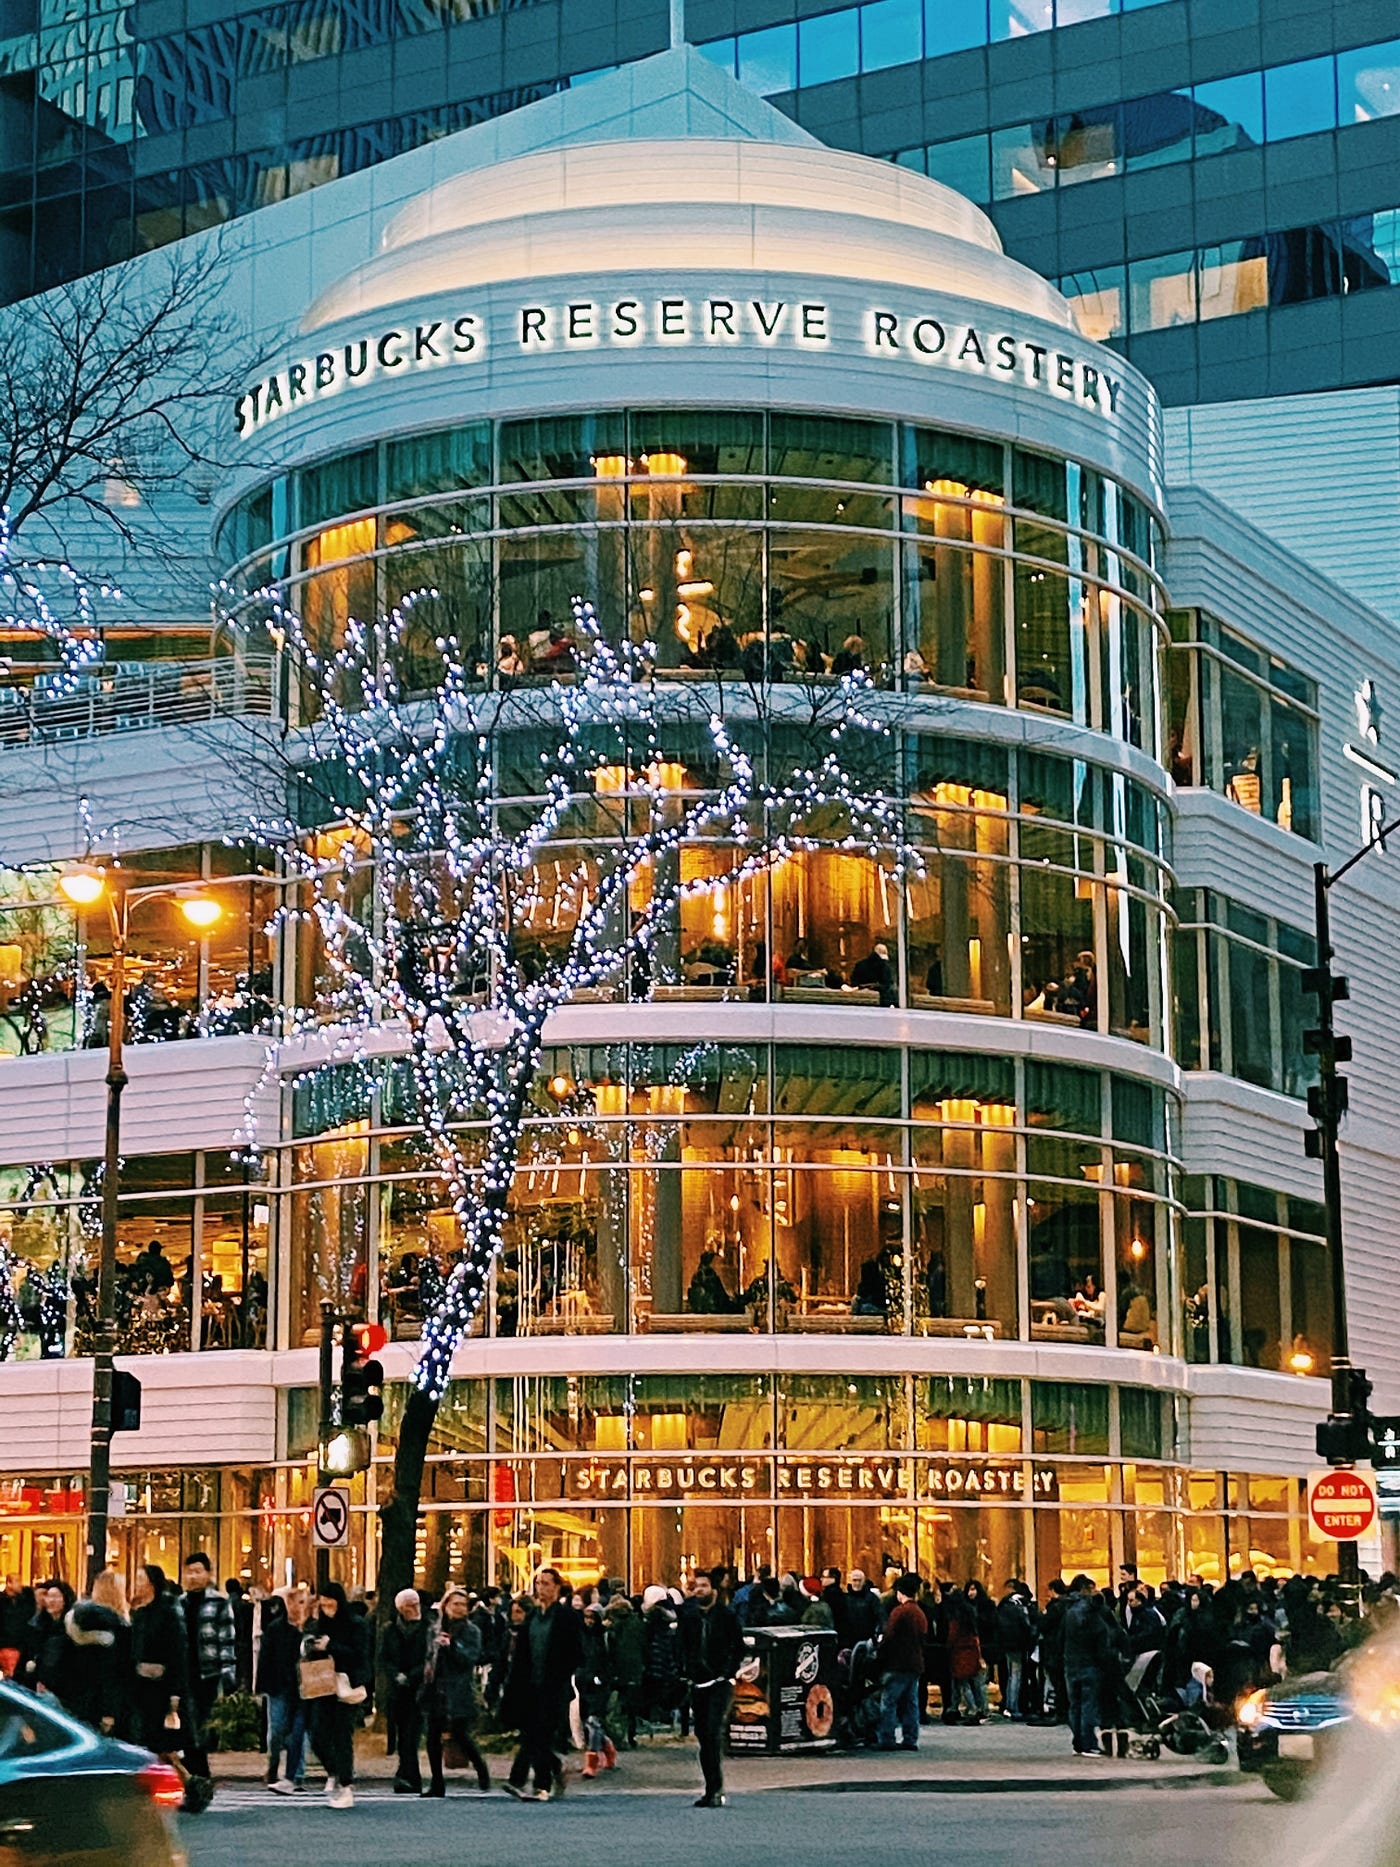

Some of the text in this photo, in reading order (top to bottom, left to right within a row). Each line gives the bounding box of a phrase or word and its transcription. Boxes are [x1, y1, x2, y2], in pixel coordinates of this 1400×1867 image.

[234, 300, 1120, 433] STARBUCKS RESERVE ROASTERY
[576, 1467, 755, 1489] STARBUCKS
[777, 1467, 910, 1489] RESERVE
[1318, 1485, 1366, 1497] DO NOT
[1324, 1515, 1362, 1527] ENTER
